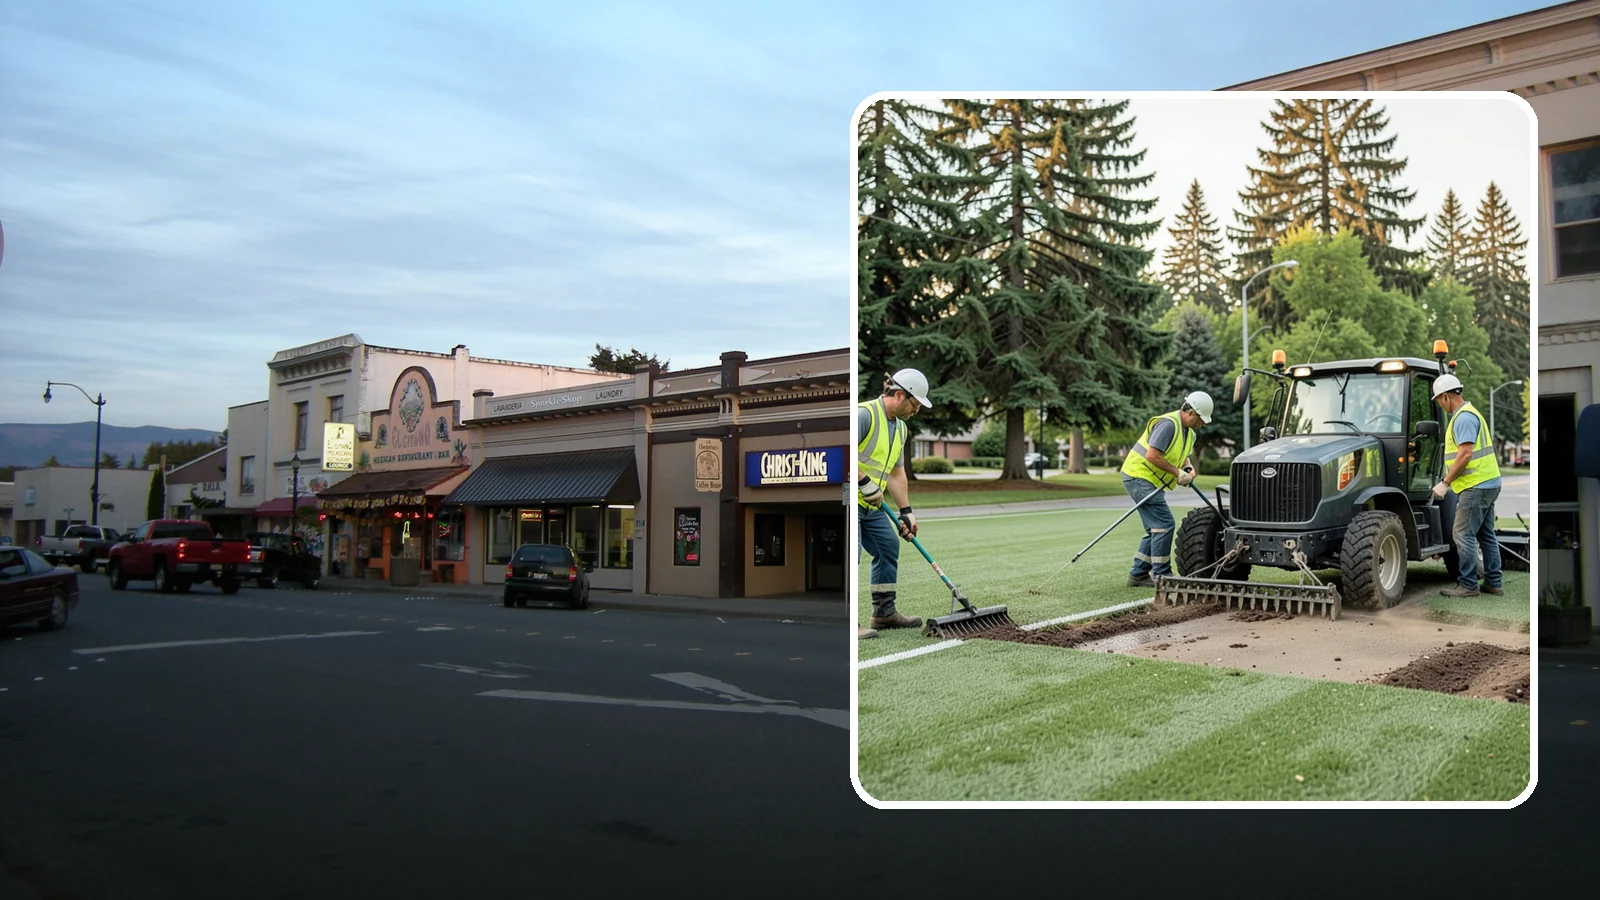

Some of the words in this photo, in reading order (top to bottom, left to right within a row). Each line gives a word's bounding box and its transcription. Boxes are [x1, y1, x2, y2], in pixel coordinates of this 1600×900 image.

[493, 402, 522, 412] LAVANDERIA
[530, 396, 562, 409] Sparkle
[562, 394, 582, 404] Shop
[595, 389, 623, 400] LAUNDRY
[327, 440, 333, 449] EL
[392, 425, 402, 449] EL
[373, 455, 396, 463] MEXICAN
[397, 452, 433, 462] RESTAURANT
[438, 450, 450, 459] BAR
[760, 452, 797, 478] CHRIST
[799, 450, 827, 476] KING
[710, 481, 722, 489] House
